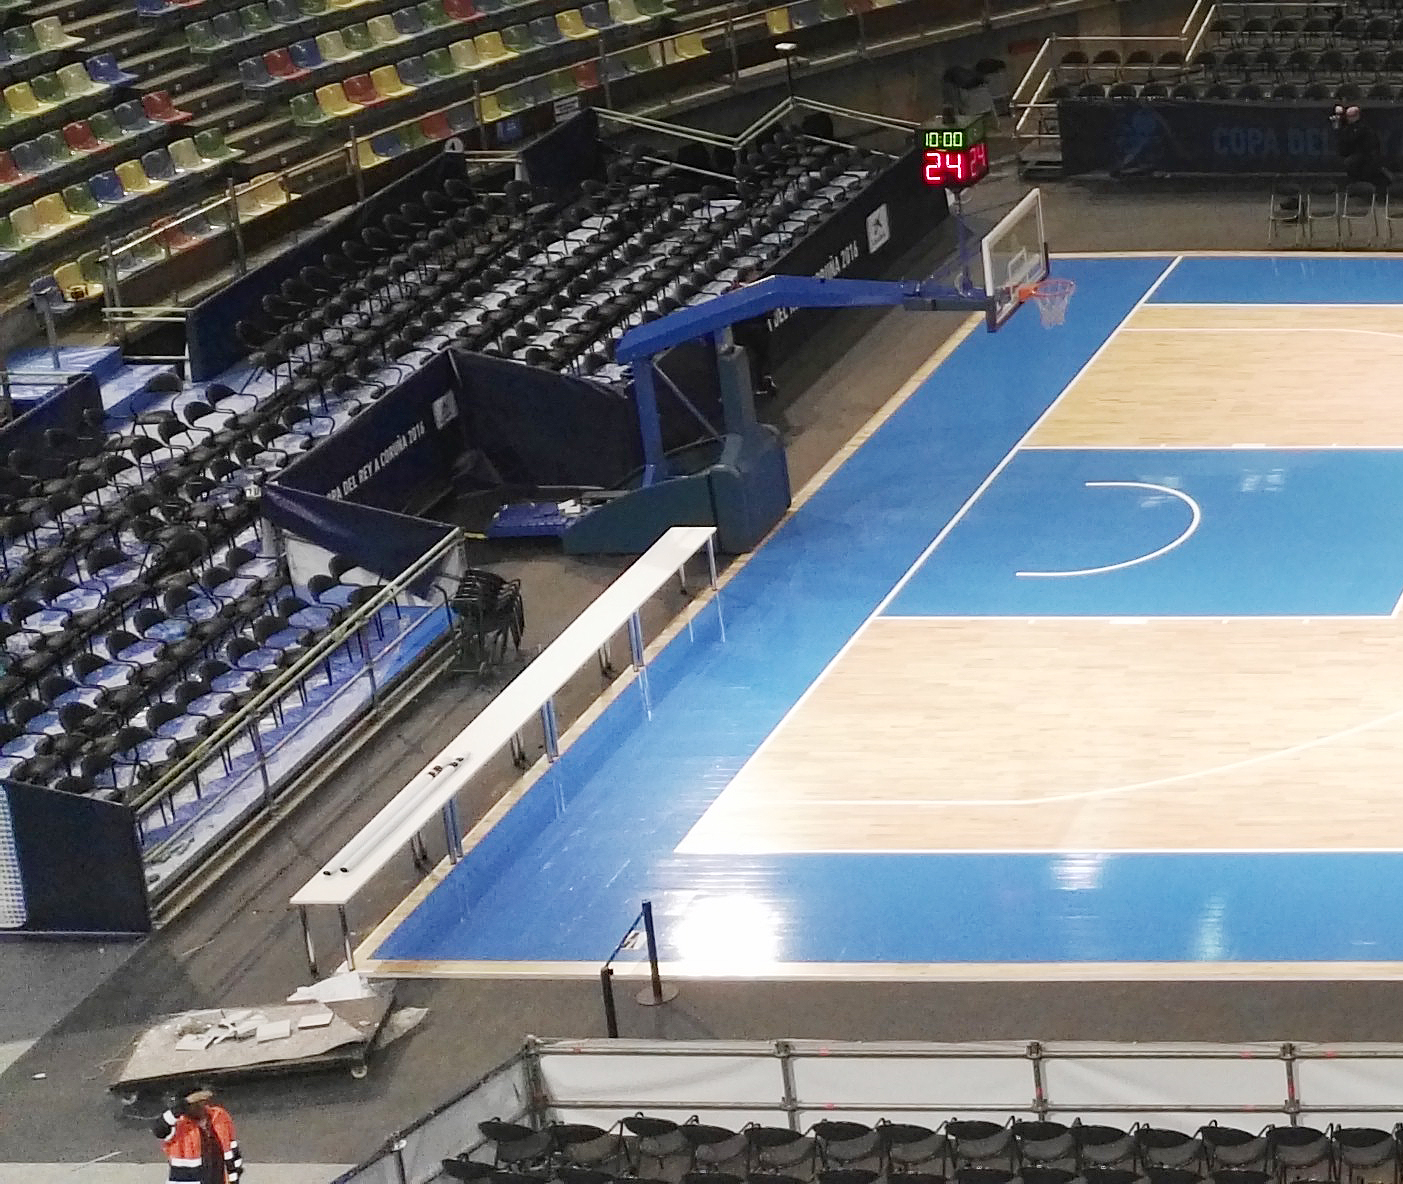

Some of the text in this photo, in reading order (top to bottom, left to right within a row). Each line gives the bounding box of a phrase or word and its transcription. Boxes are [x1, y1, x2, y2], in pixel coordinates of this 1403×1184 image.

[925, 131, 963, 147] 10:00
[1212, 127, 1281, 156] COPA
[1286, 127, 1336, 156] DEL
[925, 153, 962, 181] 24
[342, 475, 358, 496] DEL
[358, 461, 373, 484] REY
